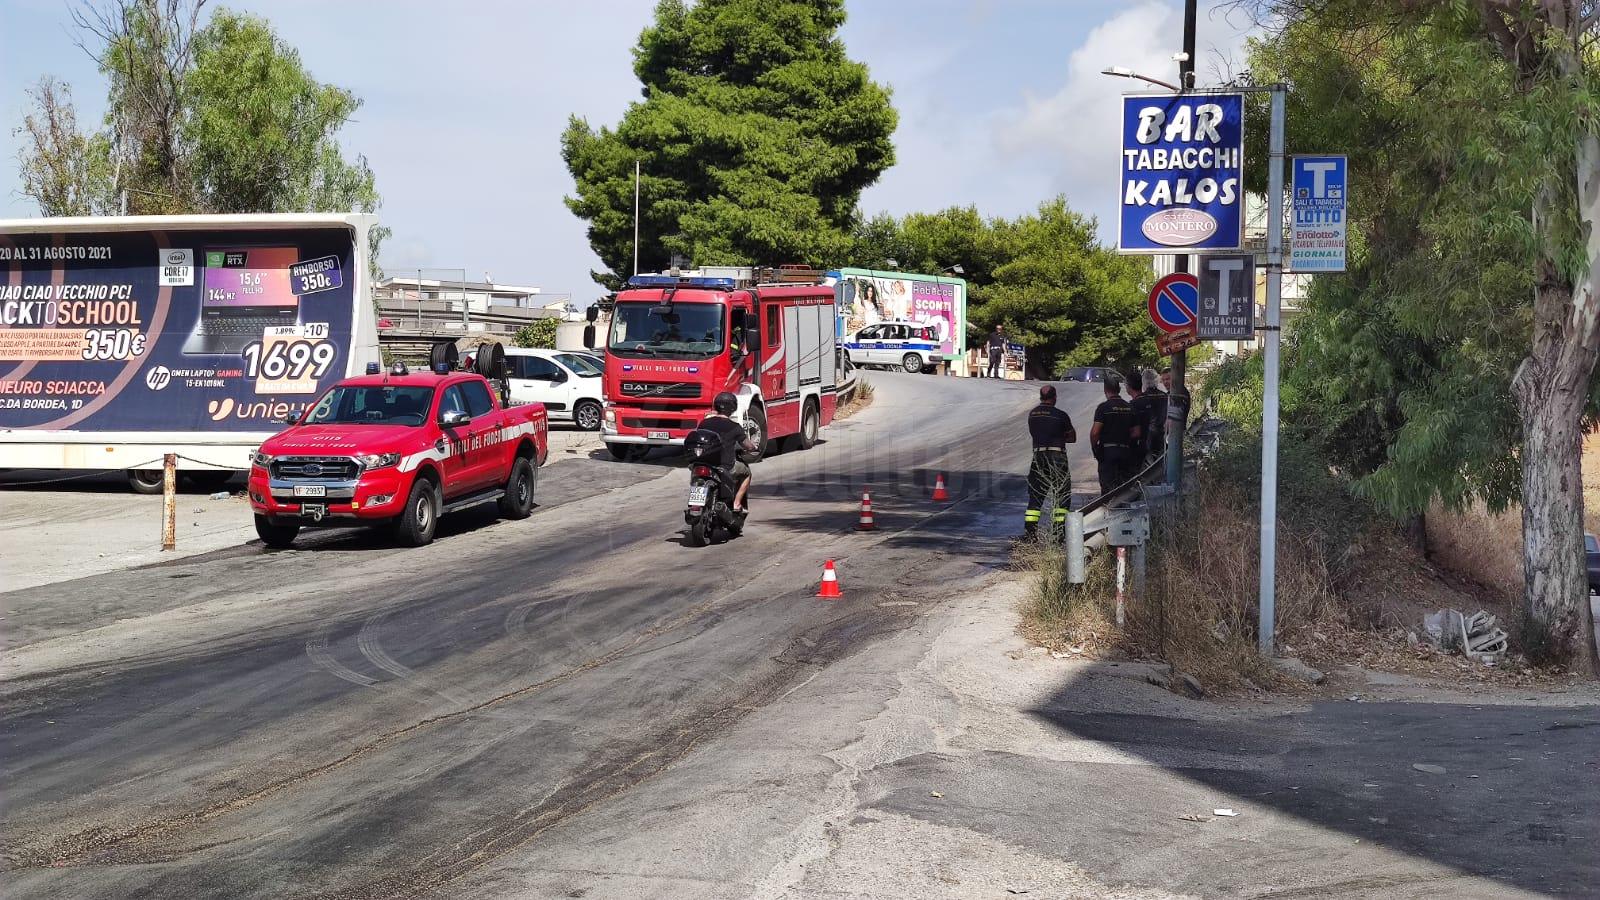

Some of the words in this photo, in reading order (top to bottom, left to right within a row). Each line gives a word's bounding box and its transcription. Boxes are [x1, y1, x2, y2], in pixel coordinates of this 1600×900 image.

[1136, 103, 1224, 144] BAR
[1124, 148, 1238, 171] TABACCHI
[1304, 162, 1337, 198] T
[1124, 178, 1238, 207] KALOS
[1297, 209, 1341, 223] LOTTO
[1146, 221, 1214, 232] MONTERO
[0, 247, 11, 259] 20
[14, 247, 27, 259] AL
[29, 247, 41, 259] 31
[44, 246, 86, 260] AGOSTO
[88, 246, 112, 259] 2021
[1293, 250, 1343, 258] GIORNALI
[227, 257, 243, 265] RTX
[293, 259, 334, 277] RIMBORSO
[164, 266, 181, 277] CORE
[182, 266, 189, 277] i7
[301, 273, 332, 291] 350€
[1208, 259, 1244, 316] T
[23, 285, 53, 300] CIAO
[56, 285, 108, 300] VECCHIO
[109, 285, 133, 299] PC!
[915, 299, 952, 311] SCONTI
[1203, 316, 1247, 326] TABACCHI
[82, 329, 146, 360] 350€
[243, 341, 336, 379] 1699
[190, 369, 215, 378] LAPTOP
[216, 369, 243, 377] GAMING
[45, 381, 106, 395] SCIACCA
[23, 399, 68, 411] BORDEA,
[71, 399, 83, 409] 1D
